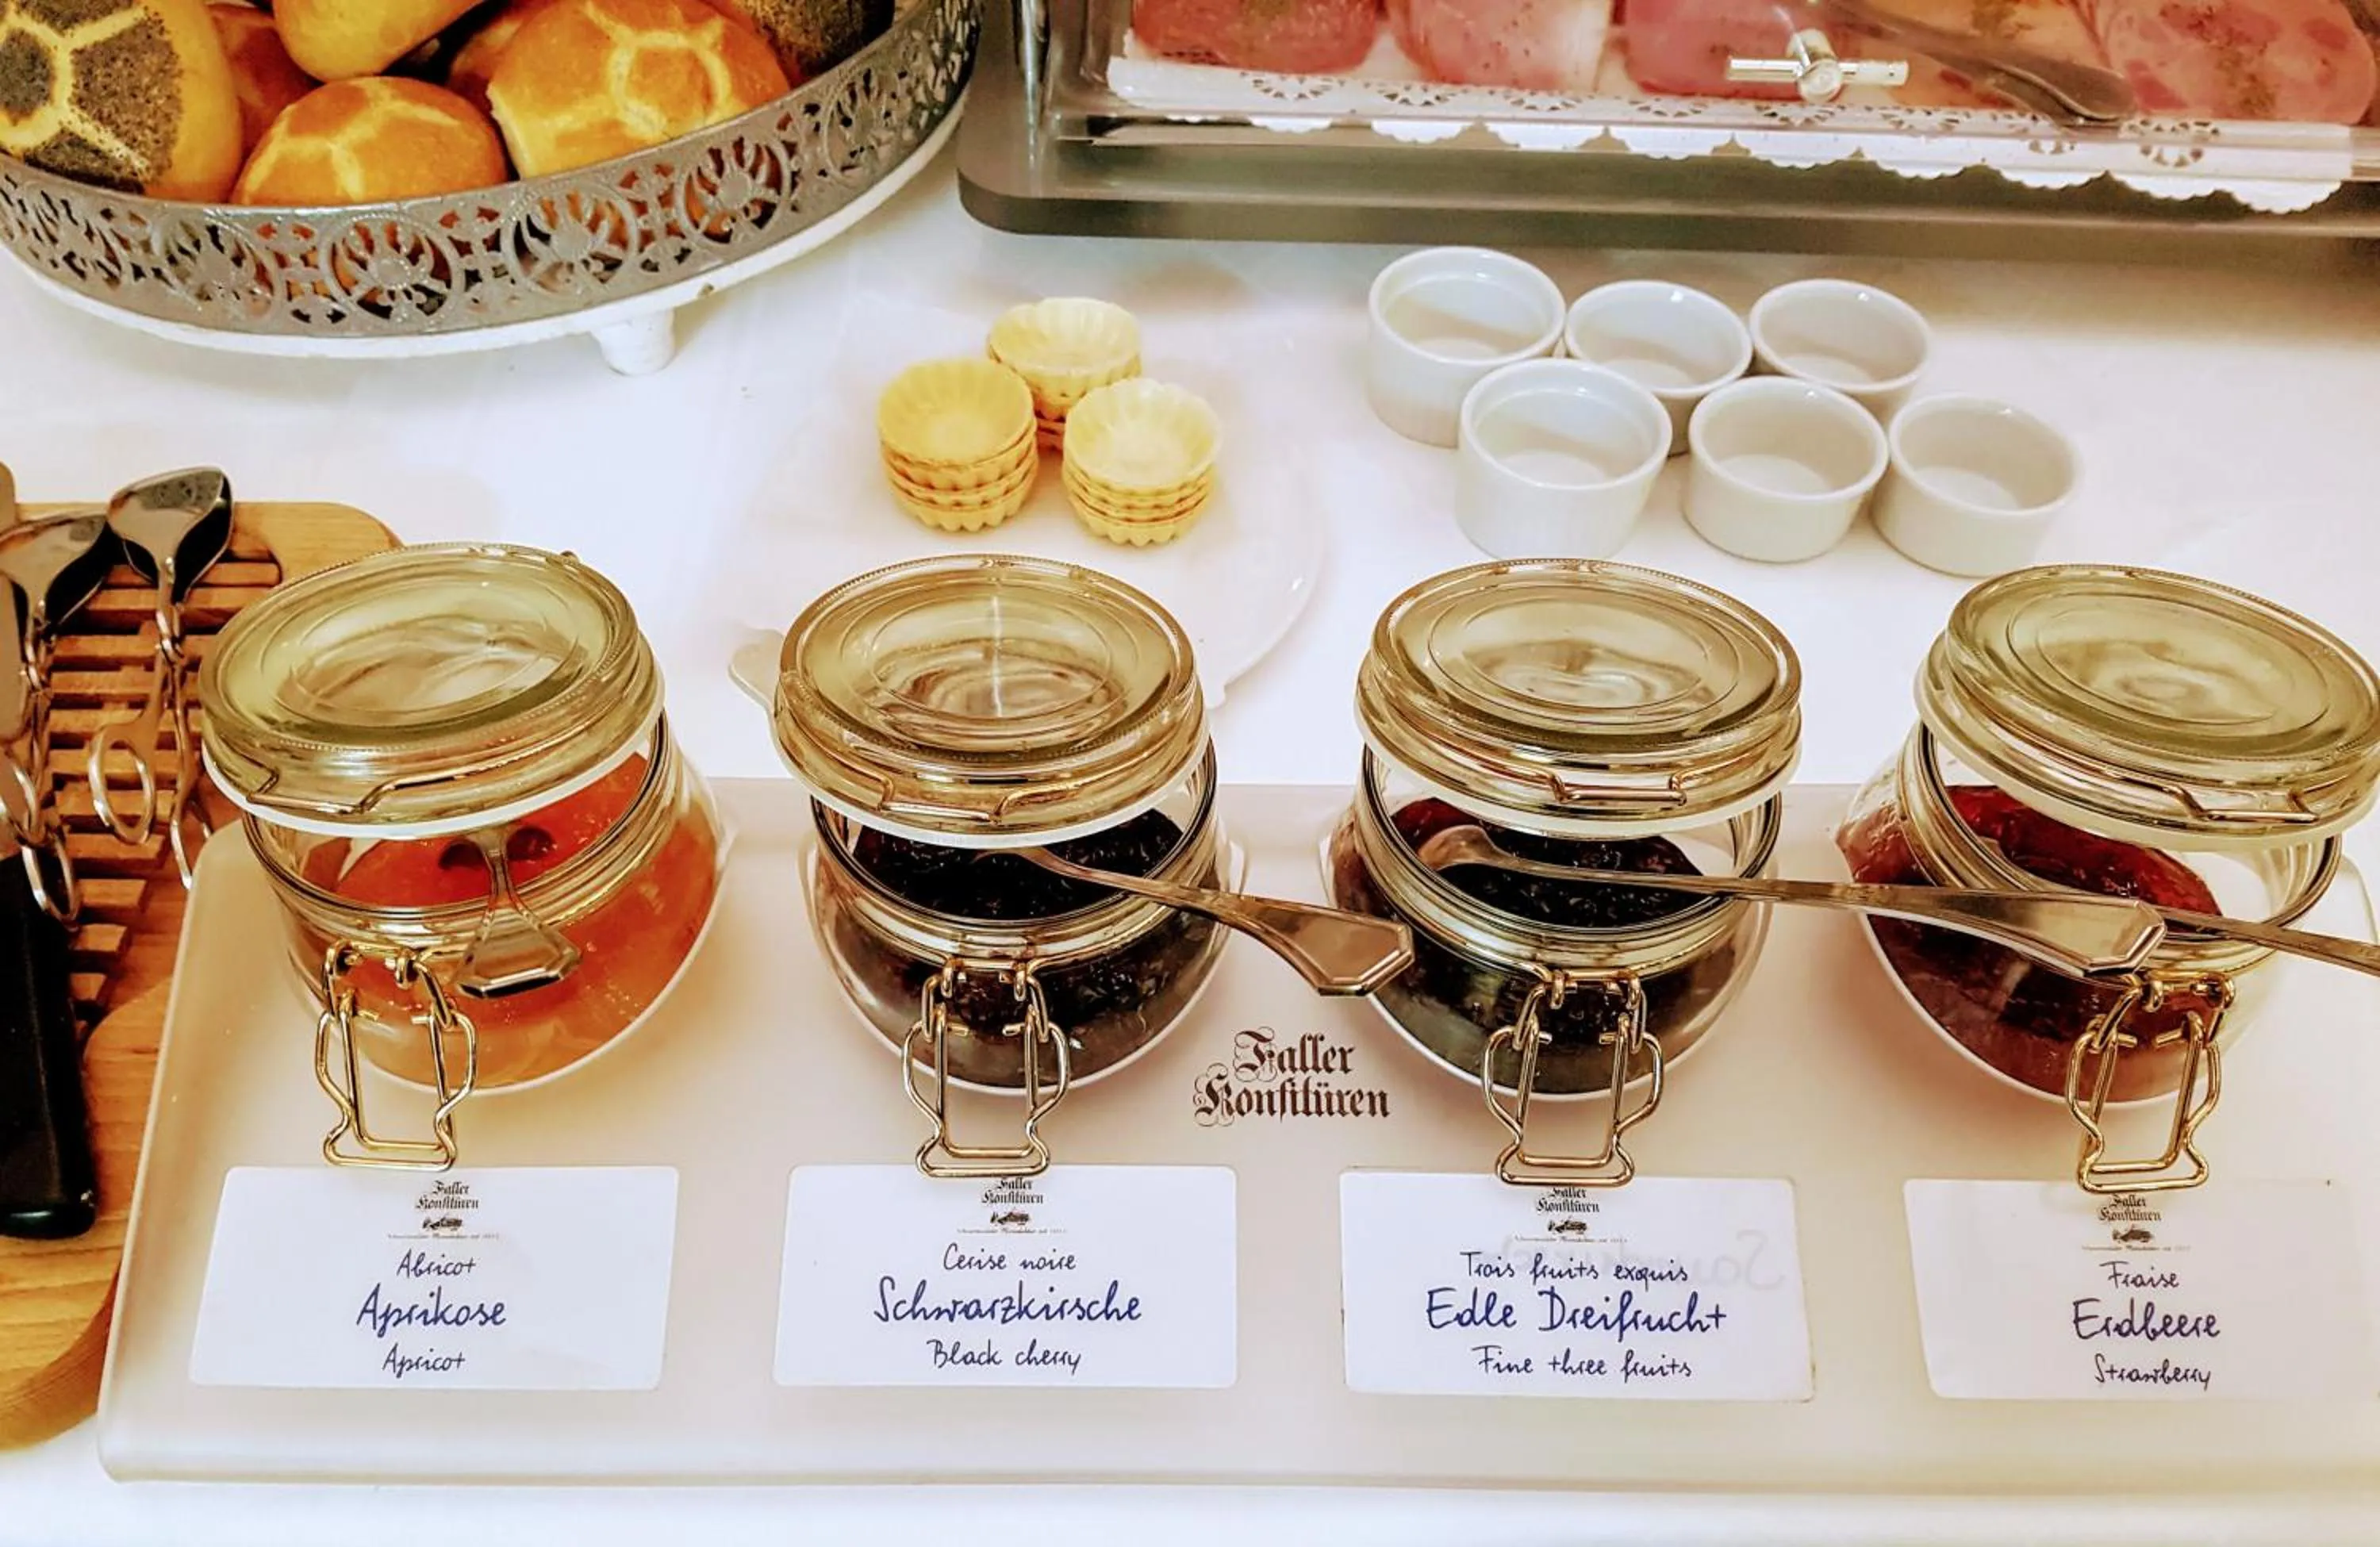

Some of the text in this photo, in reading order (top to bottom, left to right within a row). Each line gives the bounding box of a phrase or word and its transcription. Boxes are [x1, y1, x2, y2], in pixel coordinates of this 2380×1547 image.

[1233, 1026, 1355, 1082] Faller
[1192, 1062, 1391, 1127] Konfitüren
[397, 1249, 476, 1277] Abricot
[942, 1242, 1077, 1271] Cerise noire
[1460, 1251, 1515, 1278] Trois
[1530, 1252, 1599, 1284] fruits
[1613, 1258, 1689, 1292] exquis
[2099, 1261, 2180, 1288] Fraise
[356, 1283, 507, 1338] Aprikose
[873, 1276, 1142, 1325] Schwarzkirsche
[1426, 1285, 1727, 1342] Edle Dreifrucht
[2072, 1297, 2221, 1342] Erdbeere
[382, 1342, 466, 1379] Apricot
[927, 1338, 1082, 1376] Black cherry
[1471, 1345, 1692, 1384] Fine three fruits
[2094, 1353, 2212, 1392] Strawberry
